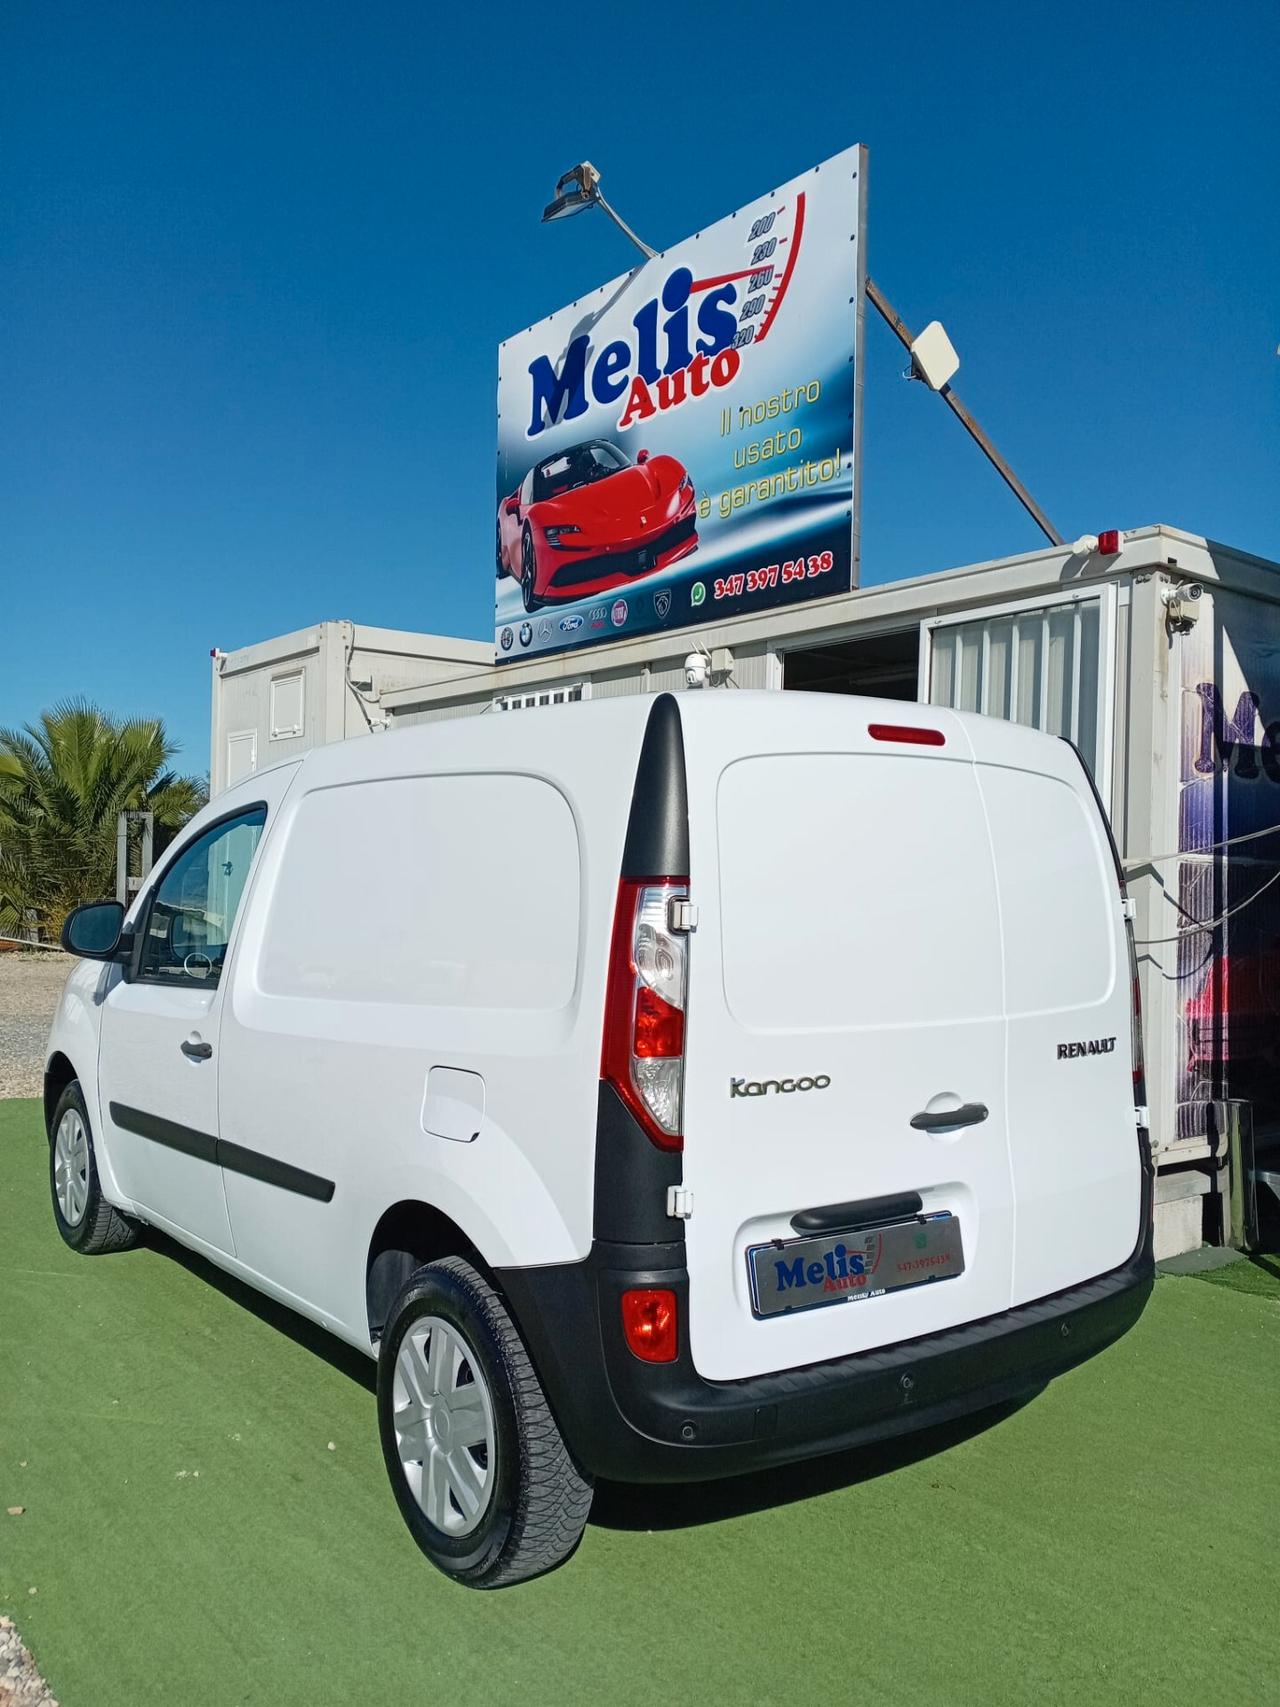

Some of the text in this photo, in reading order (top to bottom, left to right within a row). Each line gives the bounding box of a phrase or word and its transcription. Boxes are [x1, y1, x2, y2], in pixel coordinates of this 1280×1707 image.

[748, 211, 776, 242] 200
[751, 237, 777, 266] 230
[748, 268, 774, 294] 260
[739, 294, 766, 322] 290
[527, 267, 737, 436] Melis
[731, 325, 754, 350] 320
[618, 349, 740, 427] Auto
[720, 379, 820, 436] Il nostro
[734, 428, 802, 469] usato
[698, 447, 841, 518] è garantito!
[714, 551, 834, 599] 347 397 54 38
[1057, 1036, 1117, 1060] RENAULT
[774, 1244, 865, 1292] Melis
[822, 1273, 868, 1294] Auto
